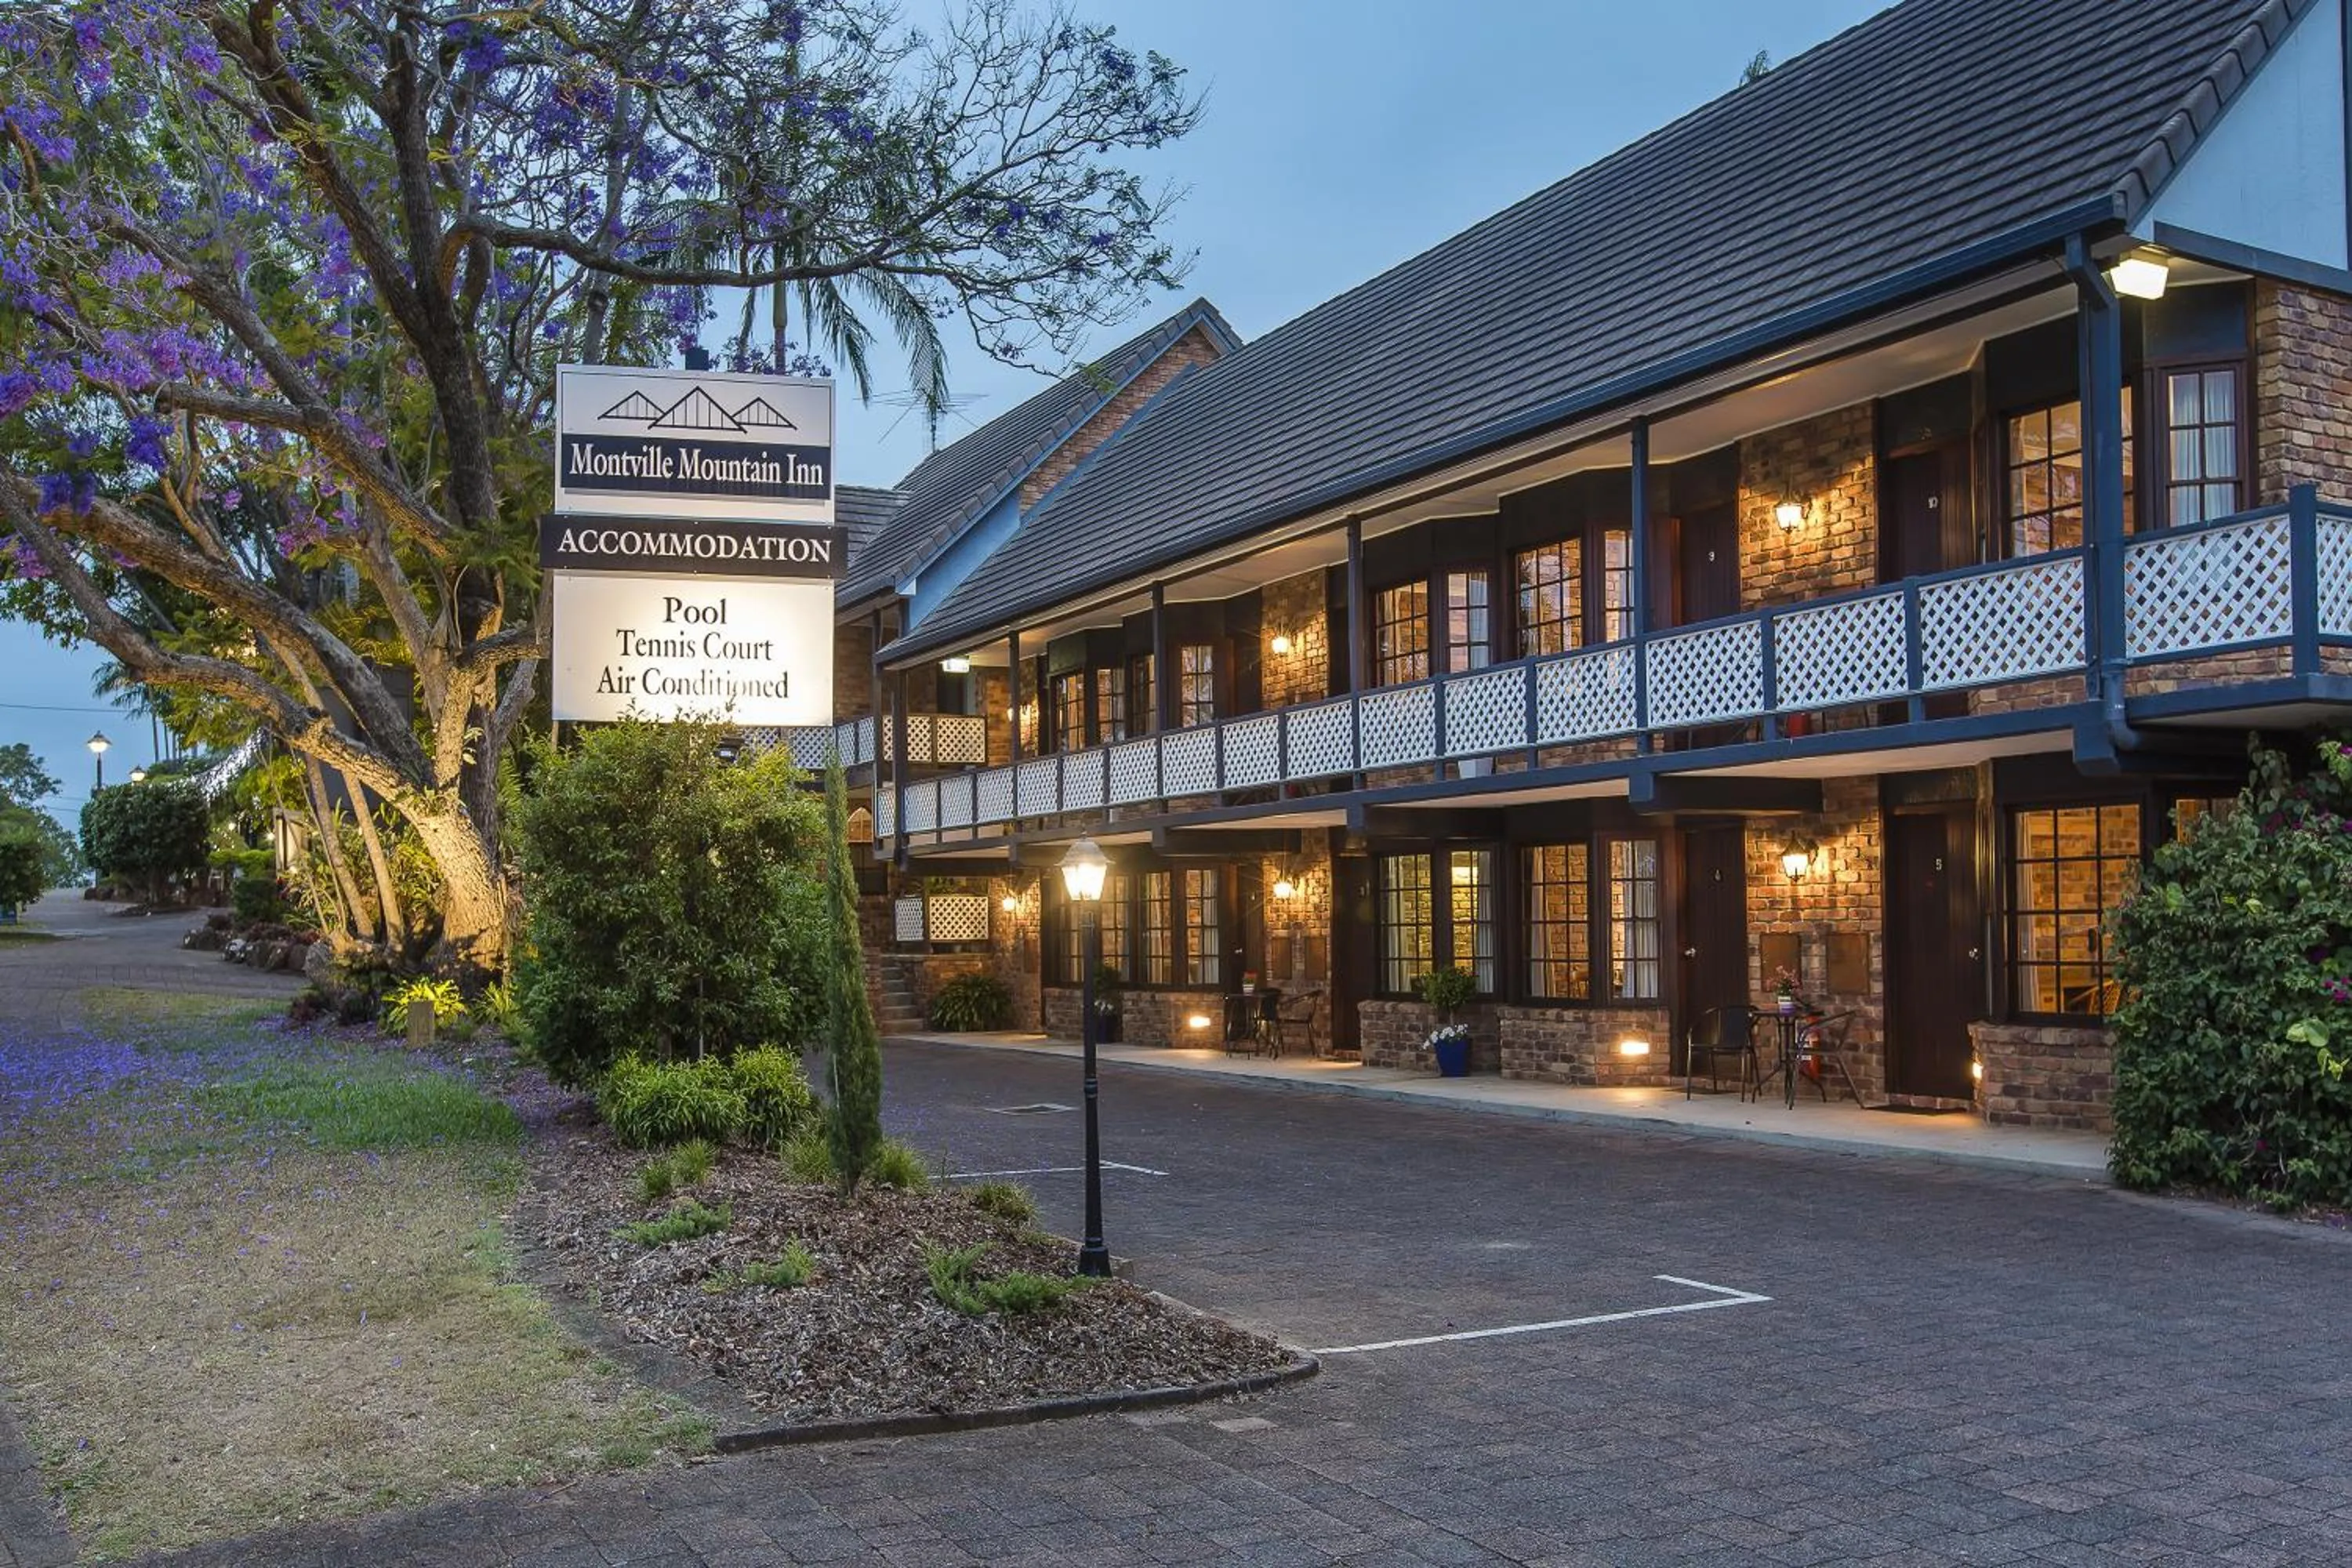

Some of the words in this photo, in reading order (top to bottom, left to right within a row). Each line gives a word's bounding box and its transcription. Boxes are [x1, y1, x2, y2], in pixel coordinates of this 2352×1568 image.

[569, 443, 673, 479] Montville
[677, 448, 782, 484] Mountain
[786, 453, 824, 485] Inn
[557, 528, 831, 563] ACCOMMODATION
[662, 597, 727, 625] Pool
[615, 629, 696, 658] Tennis
[702, 632, 775, 661] Court
[597, 666, 636, 695] Air
[642, 667, 789, 699] Conditioned
[1936, 858, 1942, 870] 5
